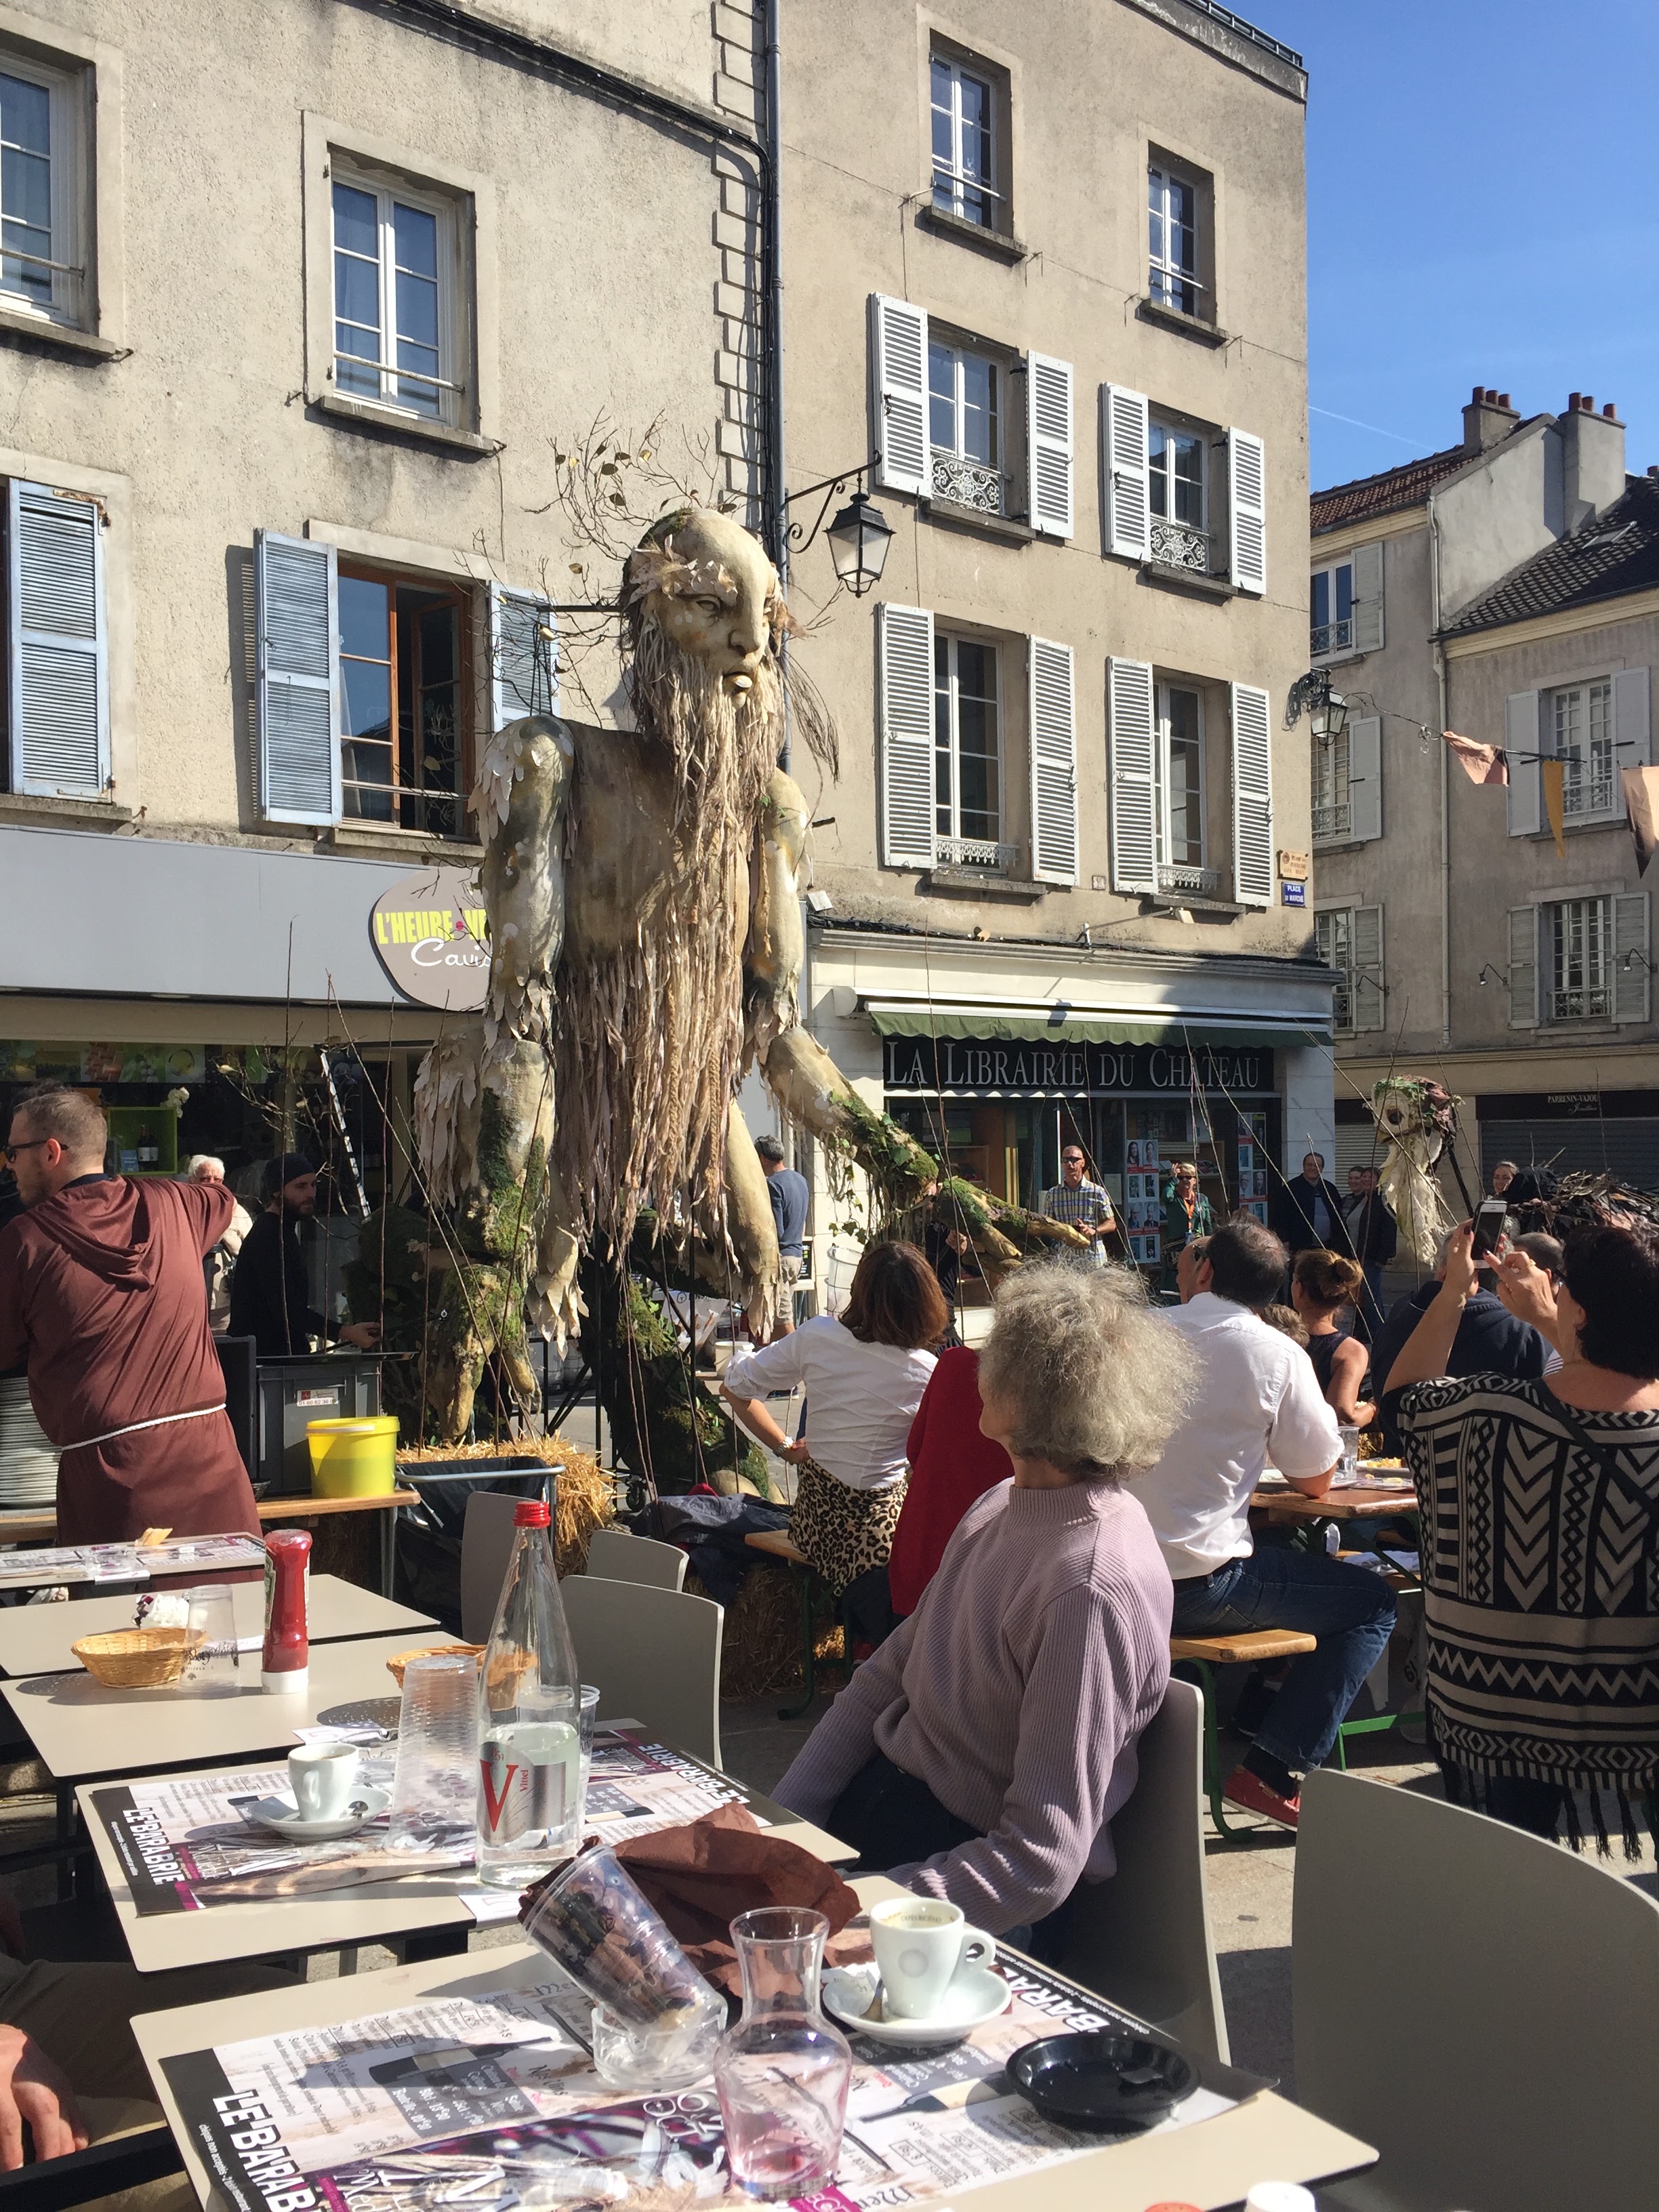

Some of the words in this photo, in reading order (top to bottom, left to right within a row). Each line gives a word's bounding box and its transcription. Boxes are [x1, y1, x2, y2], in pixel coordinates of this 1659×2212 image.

[375, 910, 454, 945] L'HEURE
[886, 1042, 928, 1084] LA
[945, 1043, 1085, 1086] LIBRAIRIE
[1099, 1053, 1135, 1086] DU
[479, 1759, 519, 1832] V
[520, 1769, 529, 1793] Vittel
[123, 1808, 156, 1823] LE
[129, 1823, 185, 1885] BARABRIE
[213, 2089, 267, 2127] LE
[230, 2125, 322, 2212] BARAB
